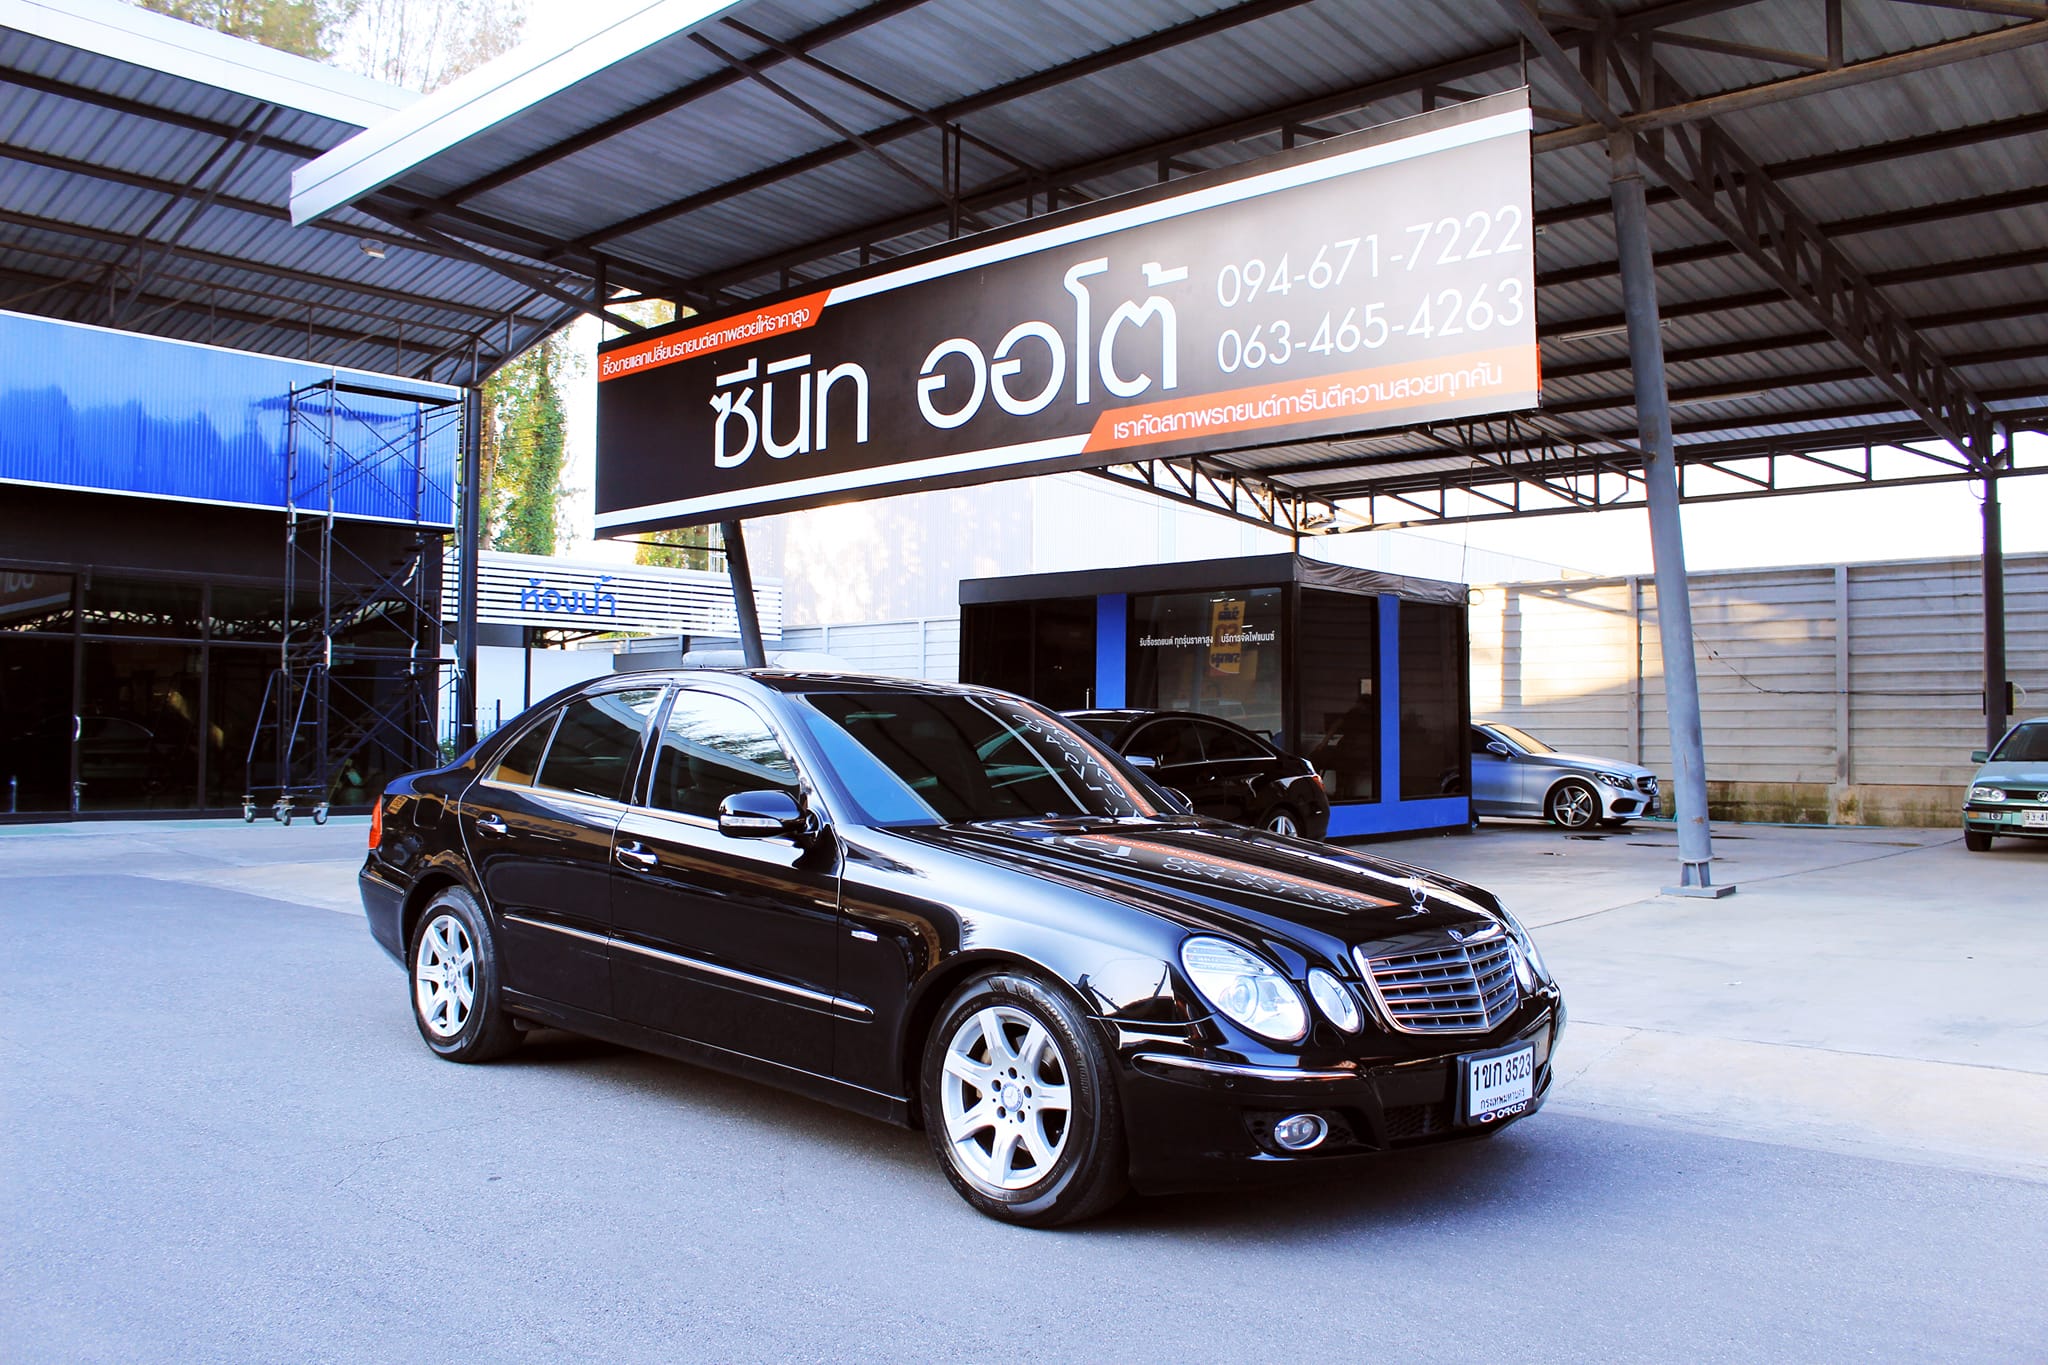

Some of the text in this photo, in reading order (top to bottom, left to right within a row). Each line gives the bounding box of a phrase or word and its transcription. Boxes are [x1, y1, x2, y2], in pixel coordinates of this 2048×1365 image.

[1217, 205, 1523, 308] 094-671-7222
[603, 308, 810, 375] ซื้อขายแลกเปลี่ยนรถยนต์สภาพสวยให้ราคาสูง
[917, 257, 1188, 429] ออโต้
[1217, 278, 1524, 374] 063-465-4263
[1114, 361, 1503, 439] เราคัดสภาพรถยนต์การันตีความสวยทุกคัน
[521, 575, 616, 616] ห้องน้ำ
[1474, 1053, 1531, 1091] 1ขก 3523
